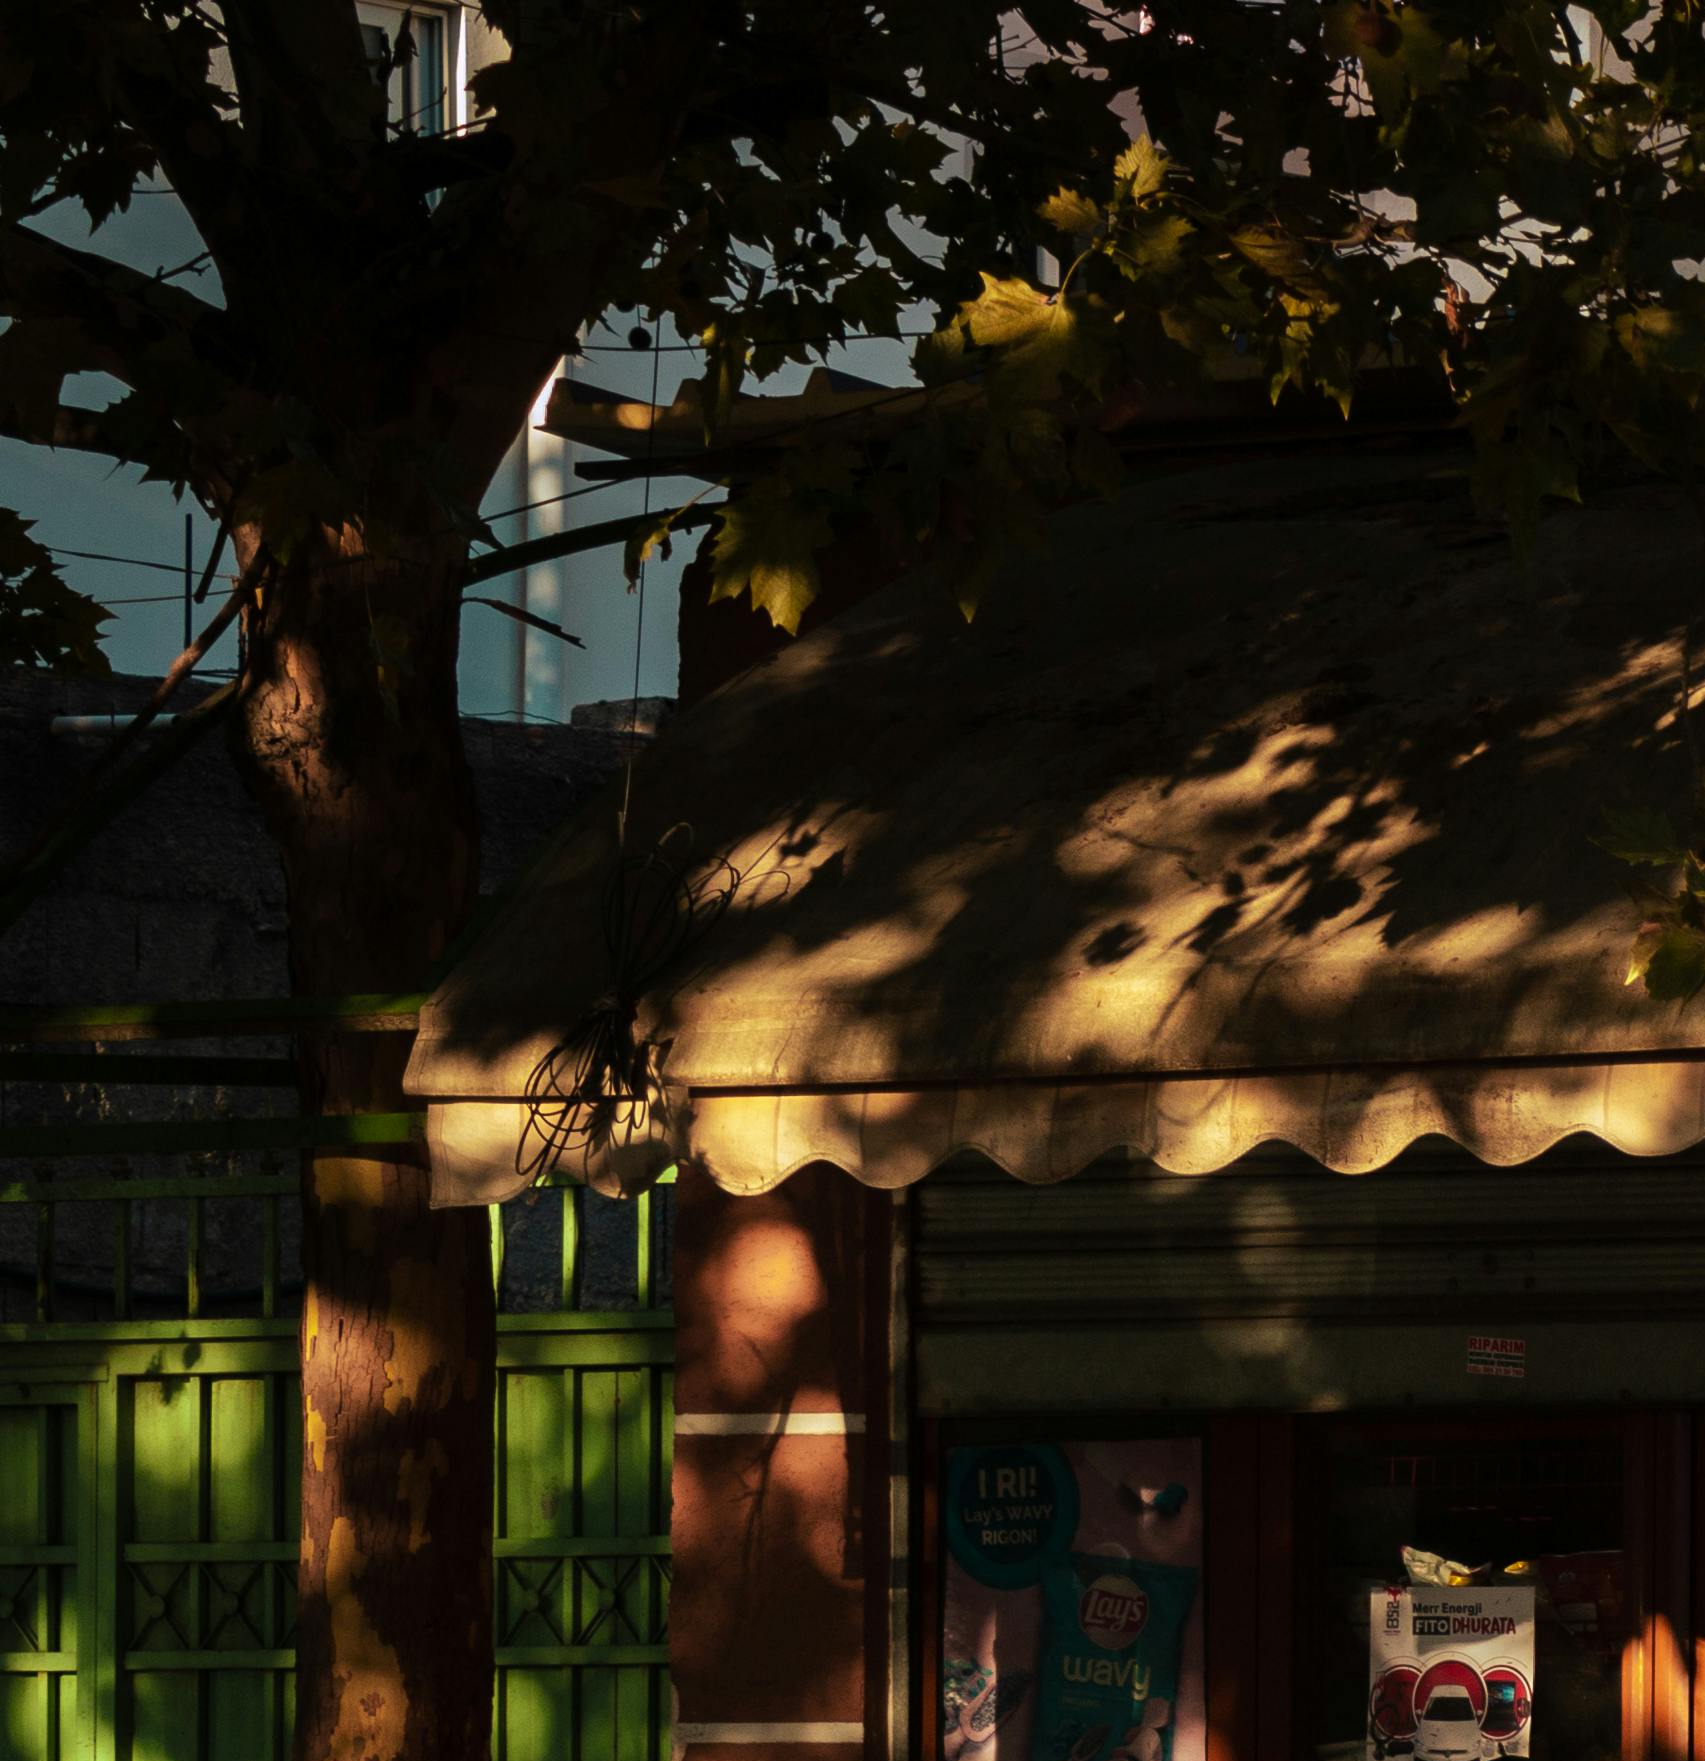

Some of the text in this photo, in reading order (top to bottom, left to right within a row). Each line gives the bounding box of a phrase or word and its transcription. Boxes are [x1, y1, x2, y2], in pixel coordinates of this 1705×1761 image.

[1469, 1338, 1524, 1353] RIPARIM
[996, 1466, 1038, 1498] RI!
[1007, 1504, 1053, 1521] WAVY
[981, 1528, 1039, 1546] RIGON!
[1084, 1589, 1145, 1632] Lay's
[1413, 1603, 1482, 1616] Merr Energji
[1415, 1617, 1516, 1635] FITO DHURATA
[1063, 1655, 1152, 1701] wavy
